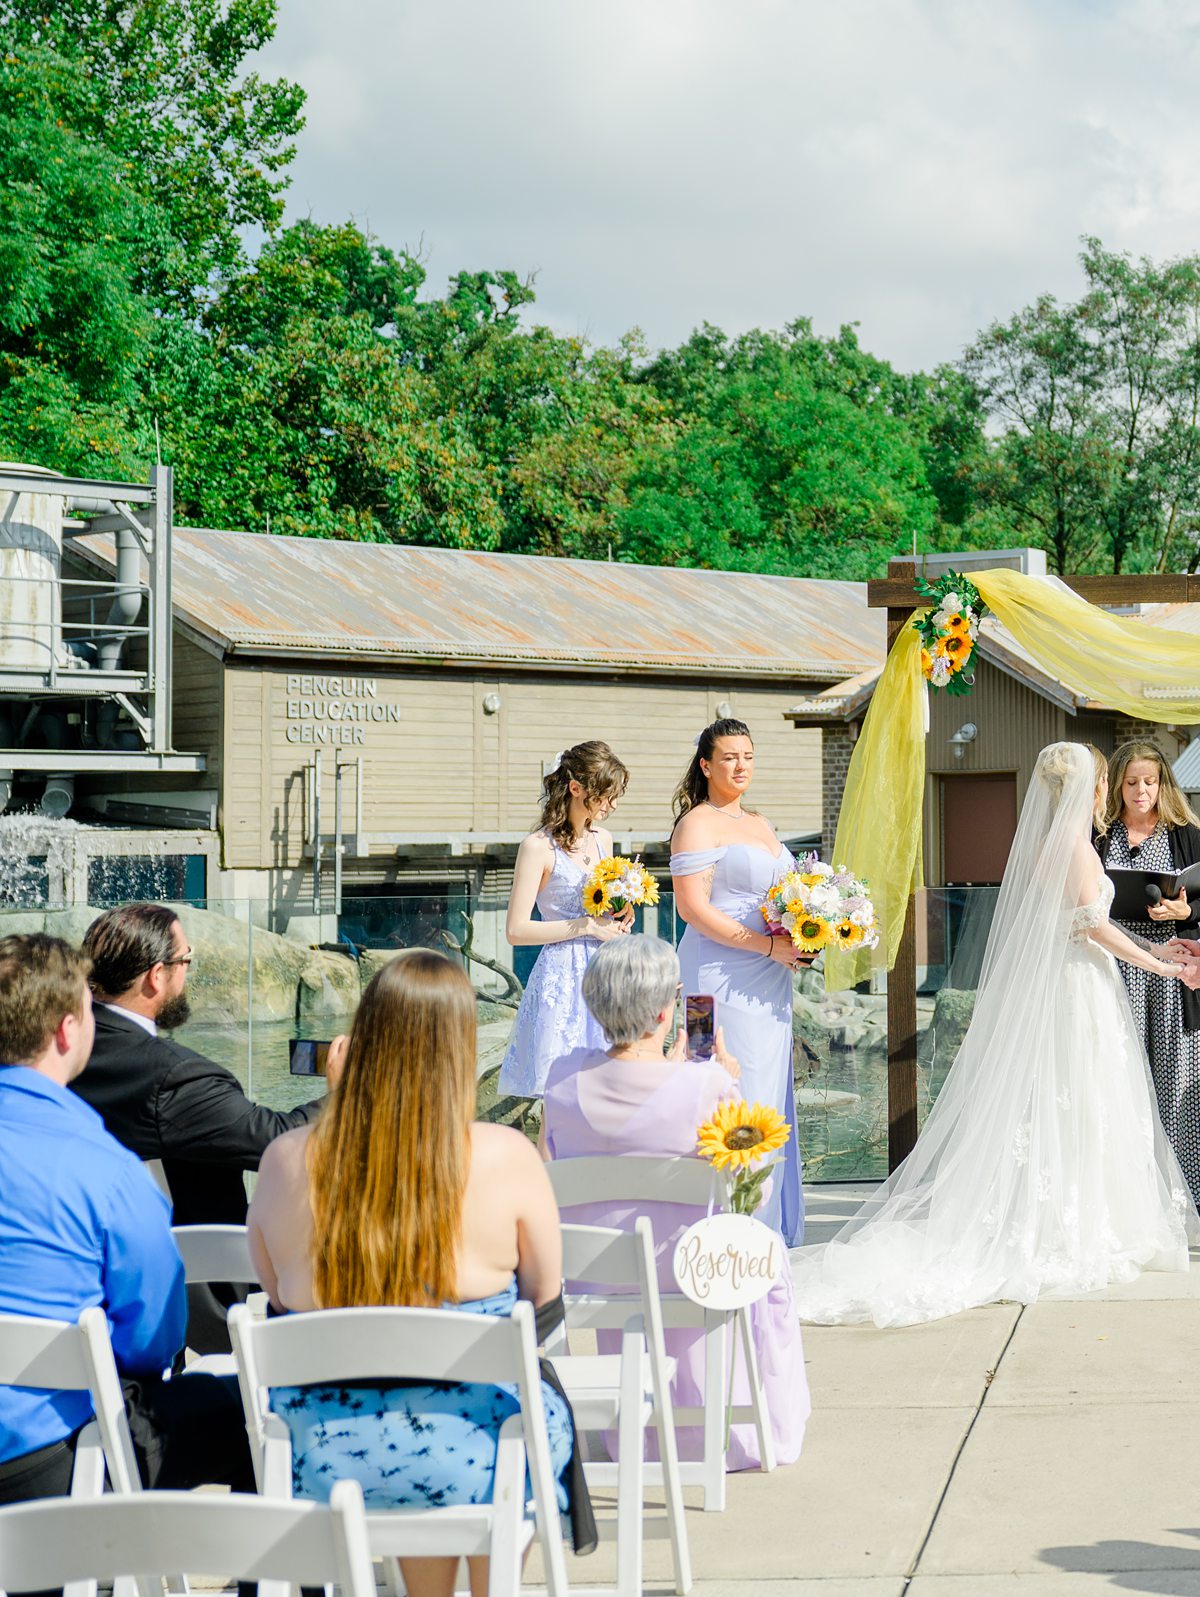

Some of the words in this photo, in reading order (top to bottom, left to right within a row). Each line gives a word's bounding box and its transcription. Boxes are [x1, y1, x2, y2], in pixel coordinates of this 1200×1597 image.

[286, 675, 377, 698] PENGUIN
[286, 699, 401, 722] EDUCATION
[286, 724, 366, 745] CENTER
[679, 1235, 776, 1298] Reserved
